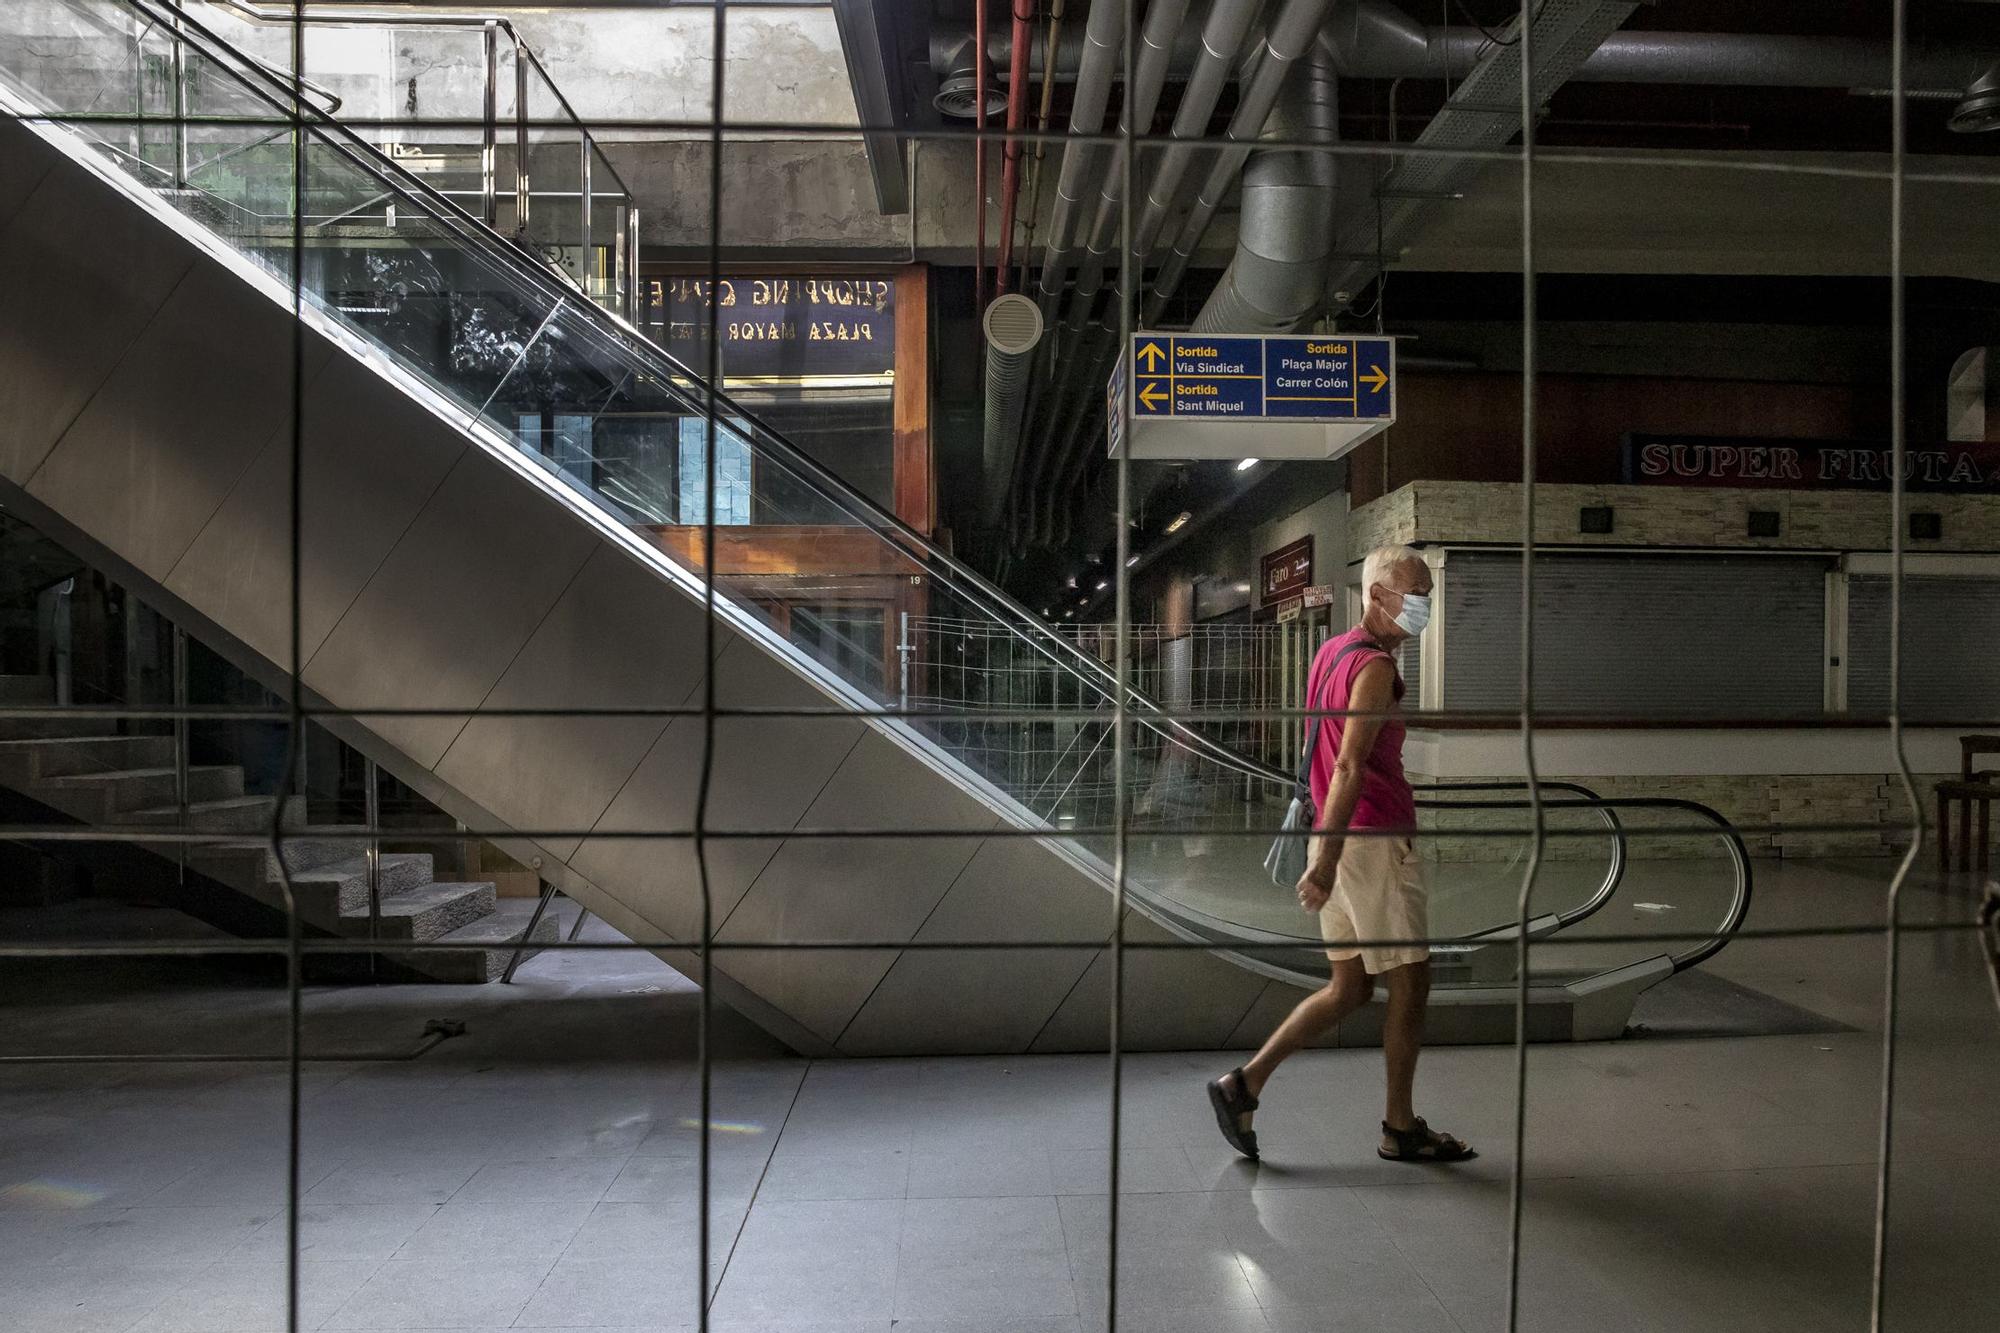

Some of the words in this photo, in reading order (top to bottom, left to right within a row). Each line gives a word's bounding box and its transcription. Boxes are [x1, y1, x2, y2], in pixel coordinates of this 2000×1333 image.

[1176, 346, 1218, 358] Sortida
[1306, 343, 1348, 354] Sortida
[1176, 362, 1194, 373] Via
[1198, 362, 1244, 374] Sindicat
[1281, 359, 1313, 371] Plaça
[1315, 360, 1348, 372] Major
[1276, 377, 1312, 388] Carrer
[1315, 377, 1348, 389] Colón
[1176, 384, 1218, 395] Sortida
[1176, 401, 1204, 412] Sant
[1206, 401, 1244, 413] Miquel
[1640, 444, 1801, 479] SUPER
[910, 575, 921, 585] 19
